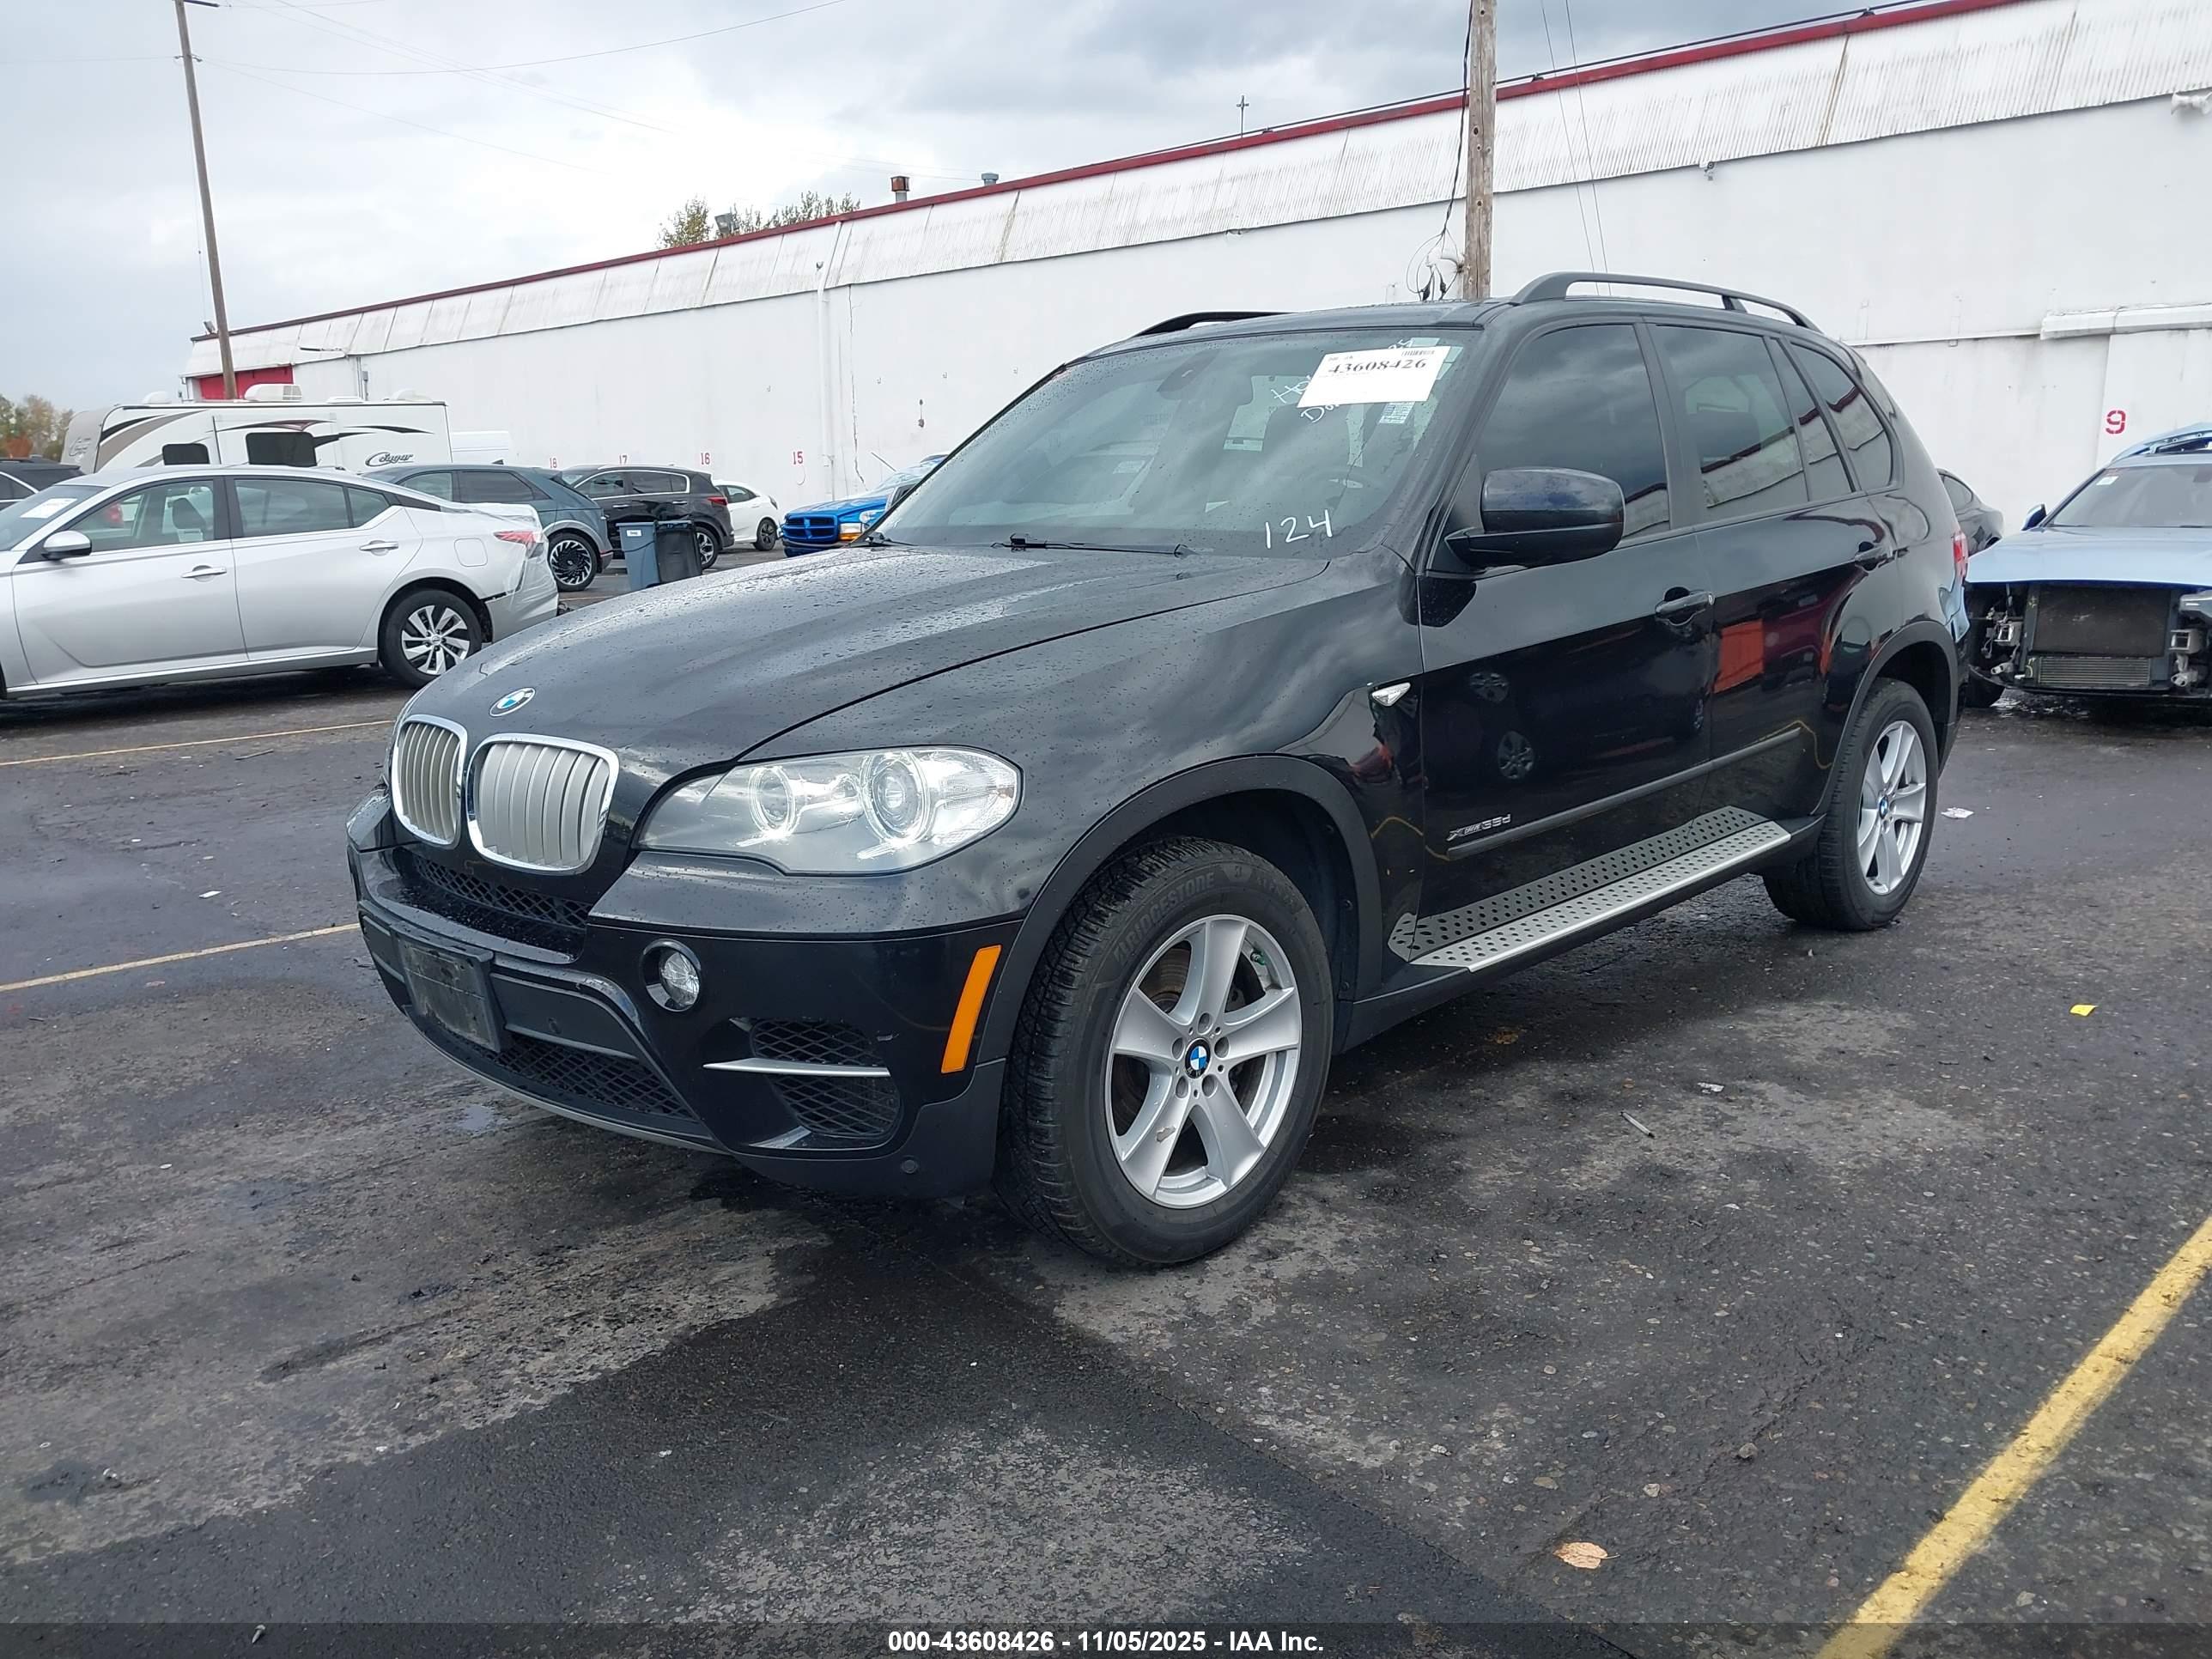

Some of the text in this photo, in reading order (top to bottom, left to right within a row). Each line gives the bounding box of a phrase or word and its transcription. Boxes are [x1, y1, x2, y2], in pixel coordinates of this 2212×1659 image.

[1328, 359, 1427, 374] 43608426
[2106, 410, 2126, 434] 9
[365, 452, 414, 467] Cougar
[550, 457, 558, 469] 18
[619, 454, 628, 465] 17
[701, 452, 711, 465] 16
[793, 451, 804, 465] 15
[1265, 509, 1333, 550] 124
[1113, 871, 1216, 963] BRIDGESTONE
